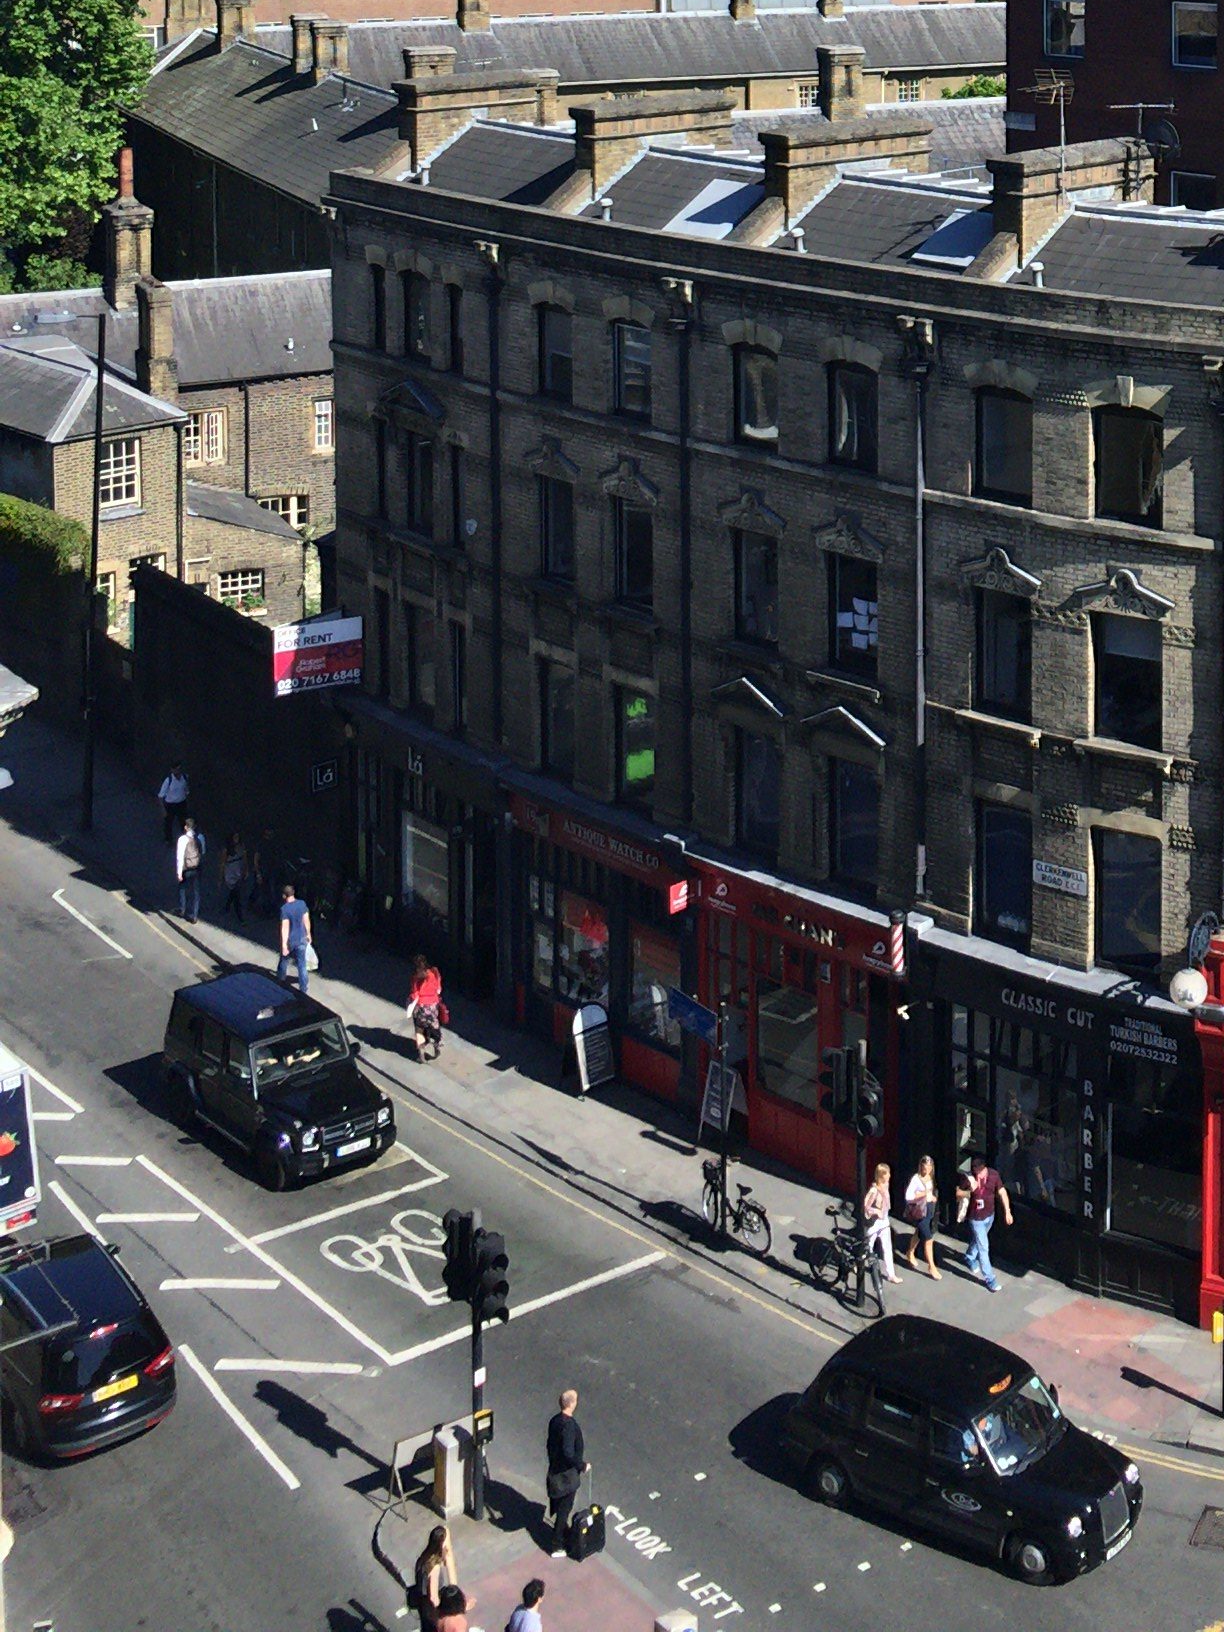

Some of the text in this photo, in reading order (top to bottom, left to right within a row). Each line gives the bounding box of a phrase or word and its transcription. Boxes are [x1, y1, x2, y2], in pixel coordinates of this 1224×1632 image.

[277, 632, 333, 650] FOR RENT
[277, 677, 299, 689] 020
[301, 672, 330, 686] 7167
[332, 667, 361, 681] 6848
[563, 818, 607, 849] ANTIQUE
[608, 836, 644, 864] WATCH
[645, 853, 660, 870] CO
[1036, 862, 1085, 882] CLERKENWELL
[1041, 873, 1063, 887] ROAD
[1001, 987, 1096, 1030] CLASSIC CUT
[1109, 1024, 1178, 1052] TURKISH BARBERS
[1083, 1079, 1095, 1219] BARBER
[614, 1516, 673, 1561] LOOK
[676, 1571, 745, 1620] LEFT
